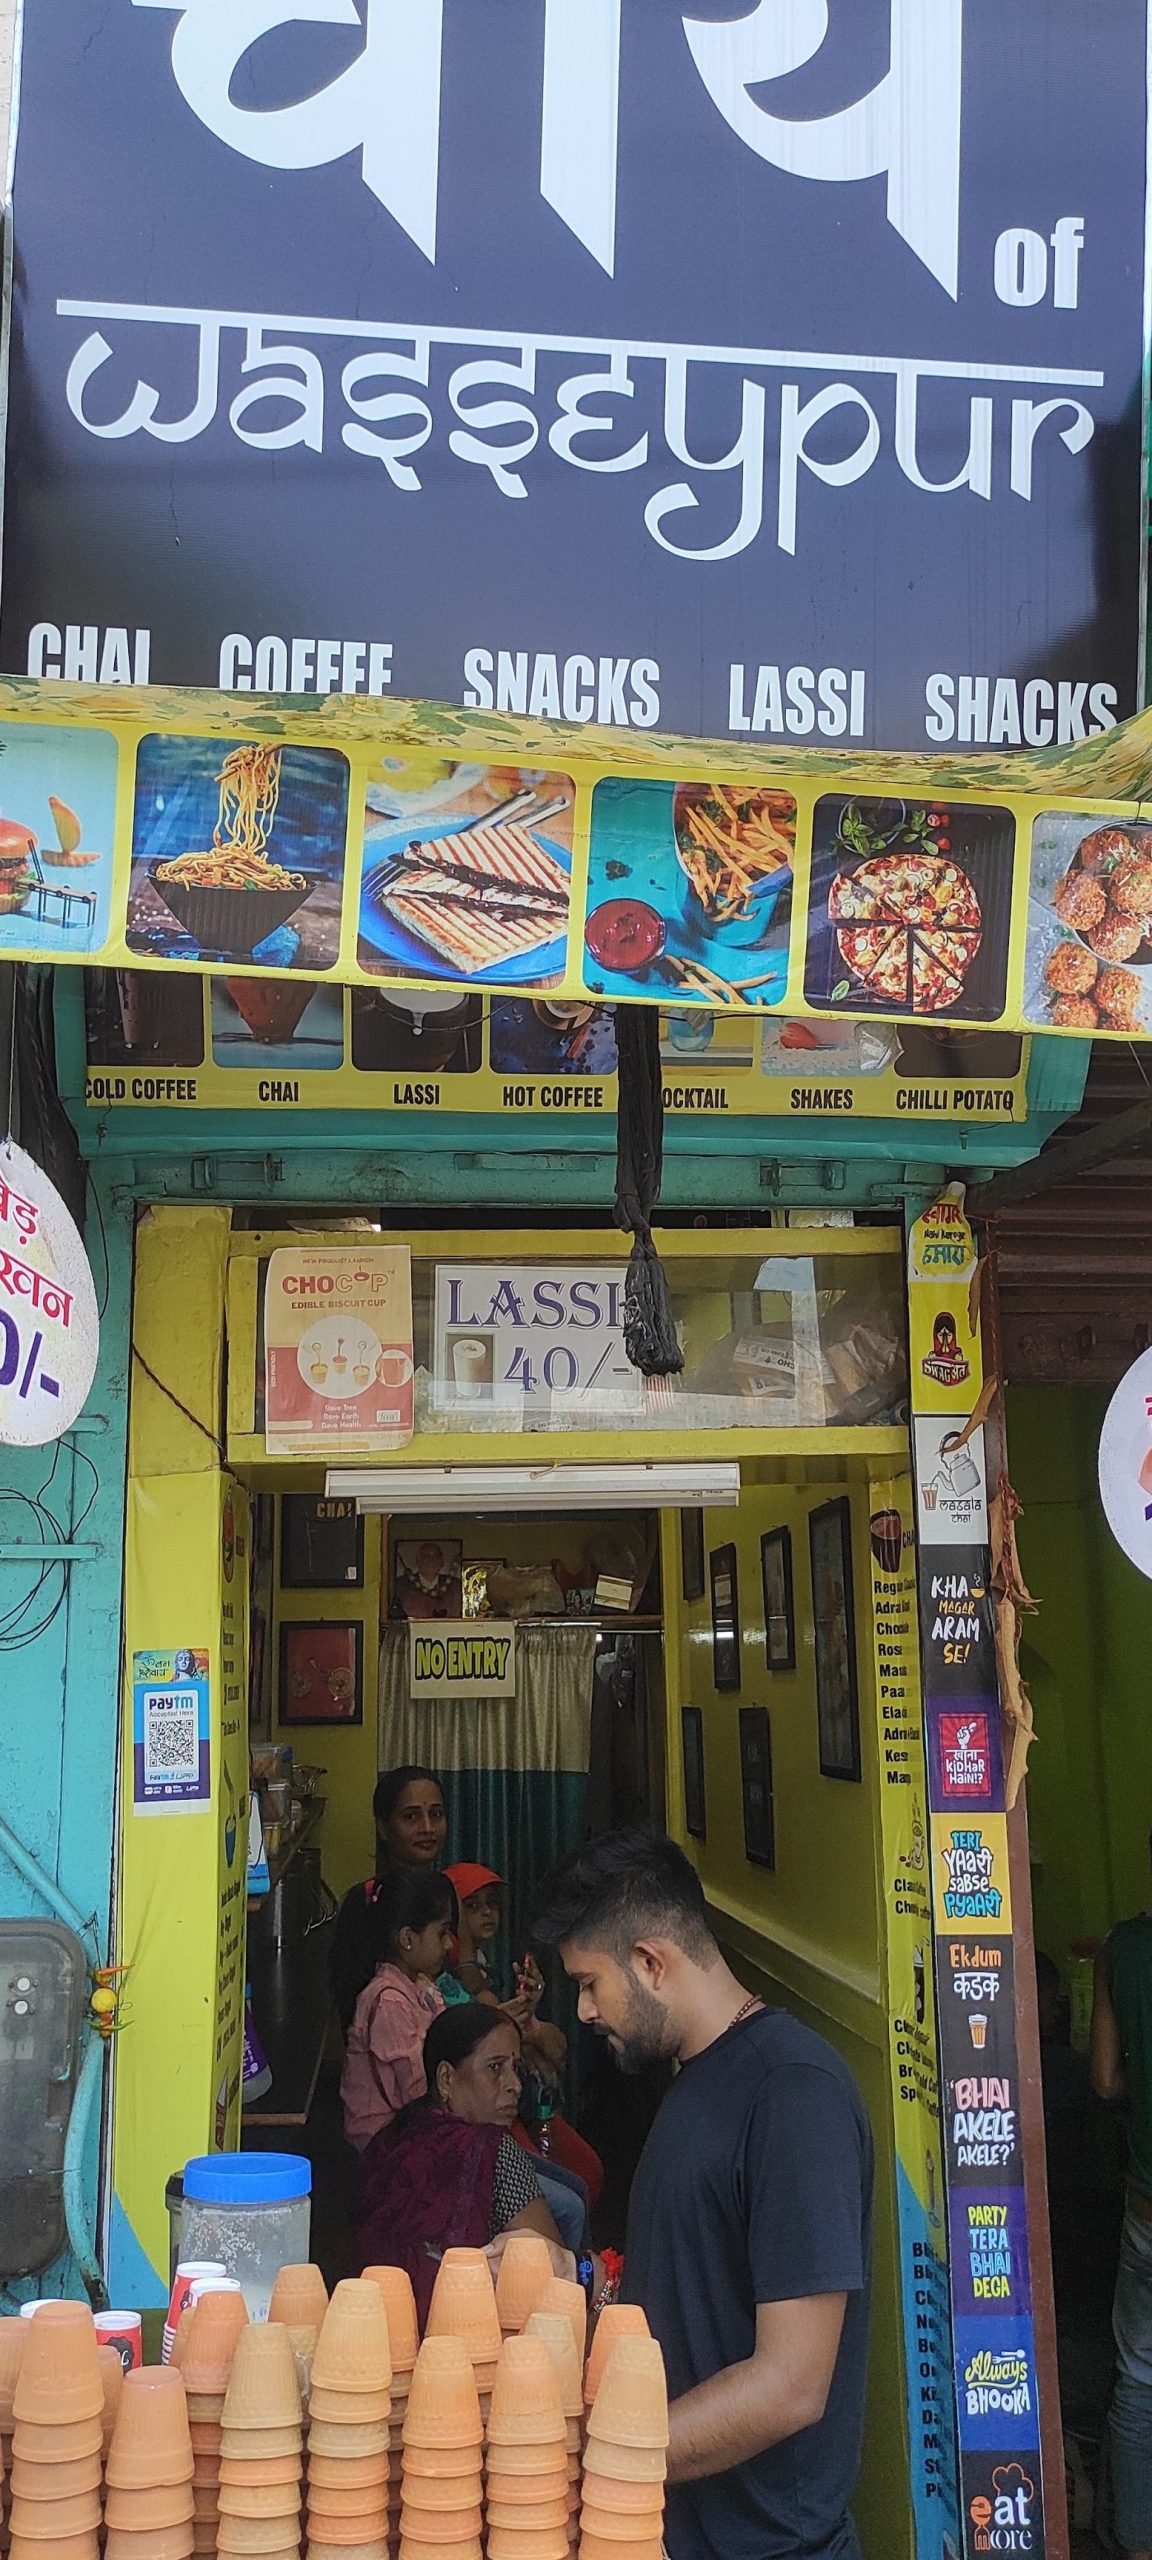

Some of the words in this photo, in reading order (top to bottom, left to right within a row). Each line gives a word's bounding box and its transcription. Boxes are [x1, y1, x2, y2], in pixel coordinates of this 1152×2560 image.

[994, 216, 1084, 309] of
[463, 647, 661, 728] SNACKS
[728, 663, 866, 738] LASSI
[925, 673, 1119, 748] SHACKS
[85, 1078, 126, 1099] COLD
[131, 1079, 197, 1101] COFFEE
[258, 1080, 299, 1102] CHAI
[393, 1083, 440, 1105] LASSI
[502, 1085, 537, 1107] HOT
[541, 1086, 603, 1108] COFFEE
[662, 1087, 729, 1110] OCKTAIL
[790, 1088, 854, 1110] SHAKES
[895, 1089, 948, 1111] CHILLI
[952, 1089, 1014, 1111] POTATO
[291, 1301, 326, 1309] EDIBLE
[328, 1299, 366, 1308] BISCUIT
[367, 1299, 387, 1307] CUP
[447, 1279, 625, 1329] LASSI
[504, 1341, 633, 1400] 40/-
[938, 1496, 982, 1511] masala
[950, 1512, 972, 1523] chai
[931, 1574, 969, 1599] KHA
[938, 1599, 975, 1616] MAGAR
[931, 1616, 980, 1642] ARAM
[415, 1637, 445, 1680] NO
[447, 1636, 511, 1680] ENTRY
[943, 1642, 971, 1664] SE!
[951, 1831, 982, 1851] TERI
[949, 1943, 1002, 1968] Ekdum
[953, 2108, 1016, 2144] AKELE
[967, 2205, 1008, 2226] PARTY
[969, 2227, 1009, 2250] TERA
[969, 2251, 1011, 2277] BHAI
[973, 2275, 1011, 2299] DEGA
[964, 2350, 1028, 2388] Always
[964, 2382, 1031, 2416] BHOOKA
[970, 2486, 1031, 2526] eat
